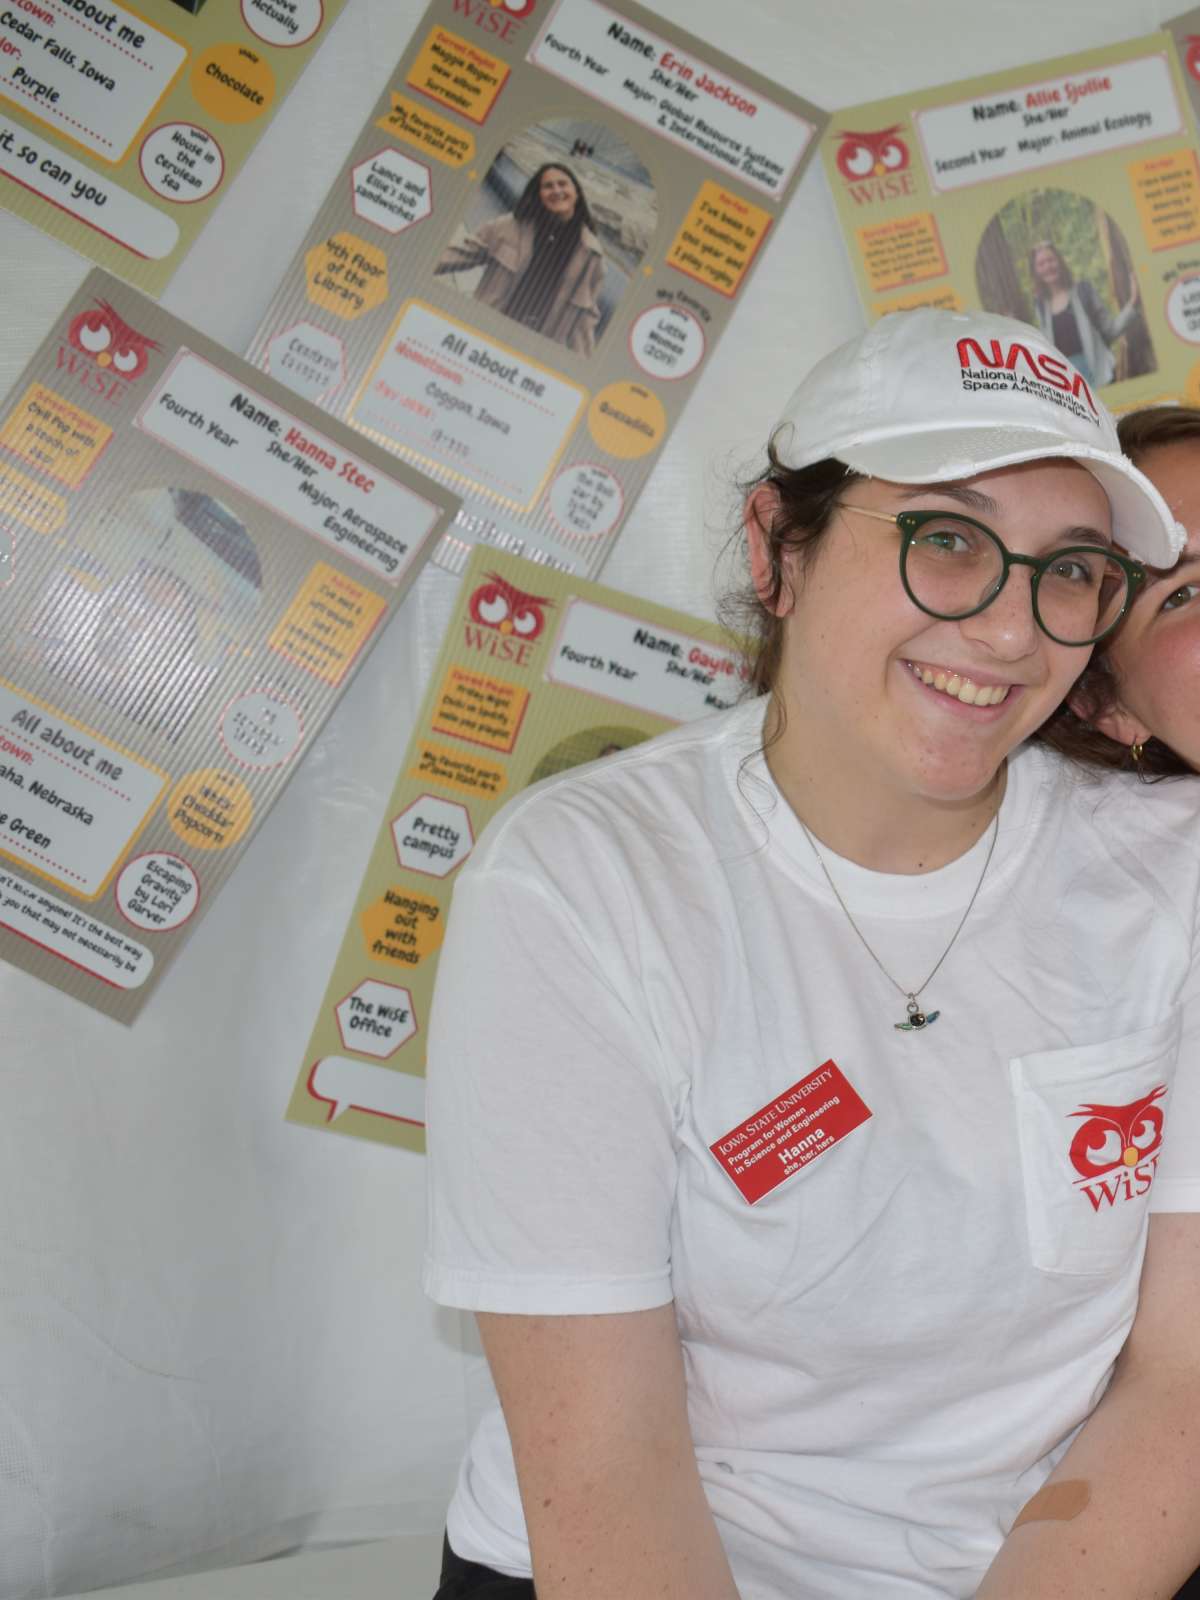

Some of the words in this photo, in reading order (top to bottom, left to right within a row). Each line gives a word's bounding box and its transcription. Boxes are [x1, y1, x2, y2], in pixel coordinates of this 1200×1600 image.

[251, 0, 299, 35] Actually
[0, 12, 42, 42] Cedar
[79, 60, 115, 90] Iowa
[117, 25, 145, 48] me
[431, 43, 465, 67] Maggie
[607, 21, 657, 61] Name:
[659, 51, 694, 82] Erin
[694, 73, 758, 117] Jackson
[13, 67, 59, 102] Purple
[205, 62, 264, 106] Chocolate
[425, 78, 472, 108] Surrender
[431, 64, 451, 79] new
[453, 76, 481, 95] album
[650, 67, 699, 102] She/Her
[544, 33, 582, 63] Fourth
[583, 55, 610, 76] Year
[623, 79, 657, 105] Major:
[659, 99, 694, 126] Global
[695, 119, 742, 153] Resource
[744, 147, 784, 177] Systems
[971, 99, 1021, 123] Name:
[1025, 88, 1062, 110] Allie
[1022, 107, 1069, 127] She/Her
[171, 131, 203, 157] House
[204, 153, 215, 164] in
[668, 122, 740, 167] International
[740, 162, 779, 188] Studies
[935, 151, 977, 174] Second
[979, 146, 1007, 163] Year
[1060, 122, 1101, 141] Animal
[1104, 111, 1152, 130] Ecology
[17, 145, 38, 165] so
[40, 160, 73, 186] can
[71, 180, 108, 206] you
[155, 154, 203, 188] Cerulean
[161, 174, 181, 192] Sea
[355, 185, 415, 222] sandwiches
[398, 193, 417, 209] sub
[404, 181, 426, 198] and
[326, 238, 350, 262] 4th
[313, 272, 365, 310] Library
[327, 261, 346, 275] of
[344, 268, 366, 289] the
[441, 334, 469, 356] All
[468, 349, 519, 385] about
[520, 377, 546, 398] me
[956, 337, 1099, 416] NASA
[961, 368, 1018, 381] National
[962, 380, 1008, 392] Space
[476, 408, 511, 436] Iowa
[230, 394, 282, 437] Name:
[284, 427, 337, 471] Hanna
[338, 461, 375, 494] Stec
[266, 441, 319, 478] She/Her
[160, 393, 205, 430] Fourth
[206, 420, 239, 448] Year
[298, 481, 340, 514] Major:
[342, 508, 407, 555] Aerospace
[323, 515, 399, 573] Engineering
[463, 620, 534, 668] WiSE
[634, 628, 684, 659] Name:
[688, 648, 735, 677] Gayle
[560, 645, 605, 671] Fourth
[607, 660, 638, 680] Year
[664, 659, 716, 686] She/Her
[11, 709, 41, 734] All
[40, 727, 95, 766] about
[95, 758, 123, 781] me
[29, 781, 94, 826] Nebraska
[9, 818, 51, 848] Green
[173, 808, 225, 843] Popcorn
[413, 816, 460, 847] Pretty
[402, 835, 456, 860] campus
[141, 874, 182, 906] Gravity
[146, 861, 192, 894] Escaping
[128, 899, 165, 924] Garver
[134, 886, 150, 903] by
[151, 895, 174, 913] Lori
[384, 890, 440, 922] Hanging
[20, 905, 41, 921] that
[42, 918, 60, 933] may
[61, 928, 78, 940] not
[77, 937, 124, 968] necessarily
[385, 929, 417, 946] with
[394, 913, 418, 930] out
[87, 923, 103, 937] the
[104, 932, 123, 947] best
[124, 944, 143, 960] way
[372, 939, 420, 965] friends
[350, 996, 373, 1015] The
[377, 1005, 409, 1024] WiSE
[350, 1015, 392, 1038] Office
[718, 1133, 749, 1156] IOWA
[745, 1110, 778, 1136] STATE
[775, 1069, 834, 1115] UNIVERSITY
[728, 1138, 764, 1166] Program
[763, 1128, 776, 1141] for
[773, 1107, 807, 1131] Women
[735, 1165, 745, 1175] in
[743, 1143, 777, 1169] Science
[777, 1131, 791, 1144] and
[792, 1095, 841, 1132] Engineering
[778, 1128, 826, 1165] Hanna
[816, 1135, 836, 1151] hers
